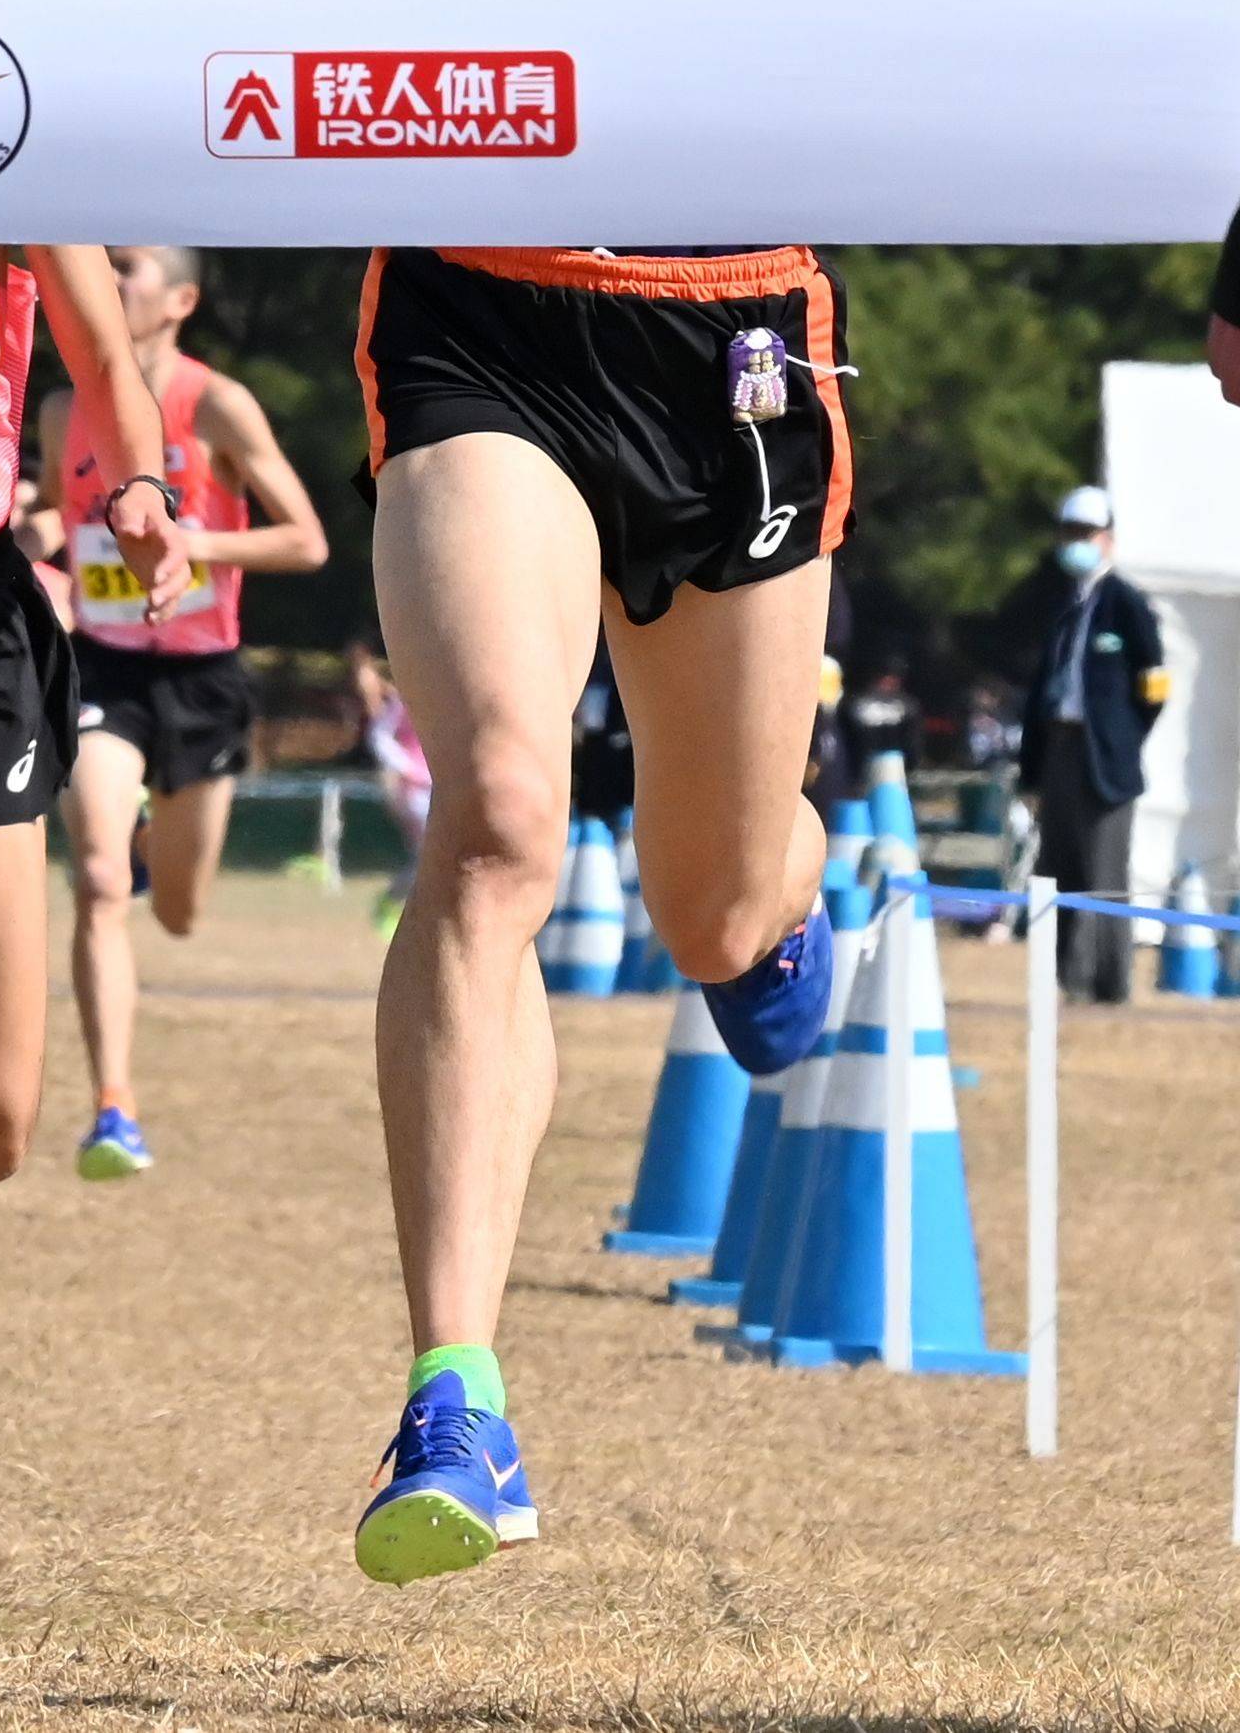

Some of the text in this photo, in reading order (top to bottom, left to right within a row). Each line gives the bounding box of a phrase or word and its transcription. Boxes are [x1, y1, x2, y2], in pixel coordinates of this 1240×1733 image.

[312, 61, 557, 116] 铁人体育
[317, 119, 557, 147] IRONMAN
